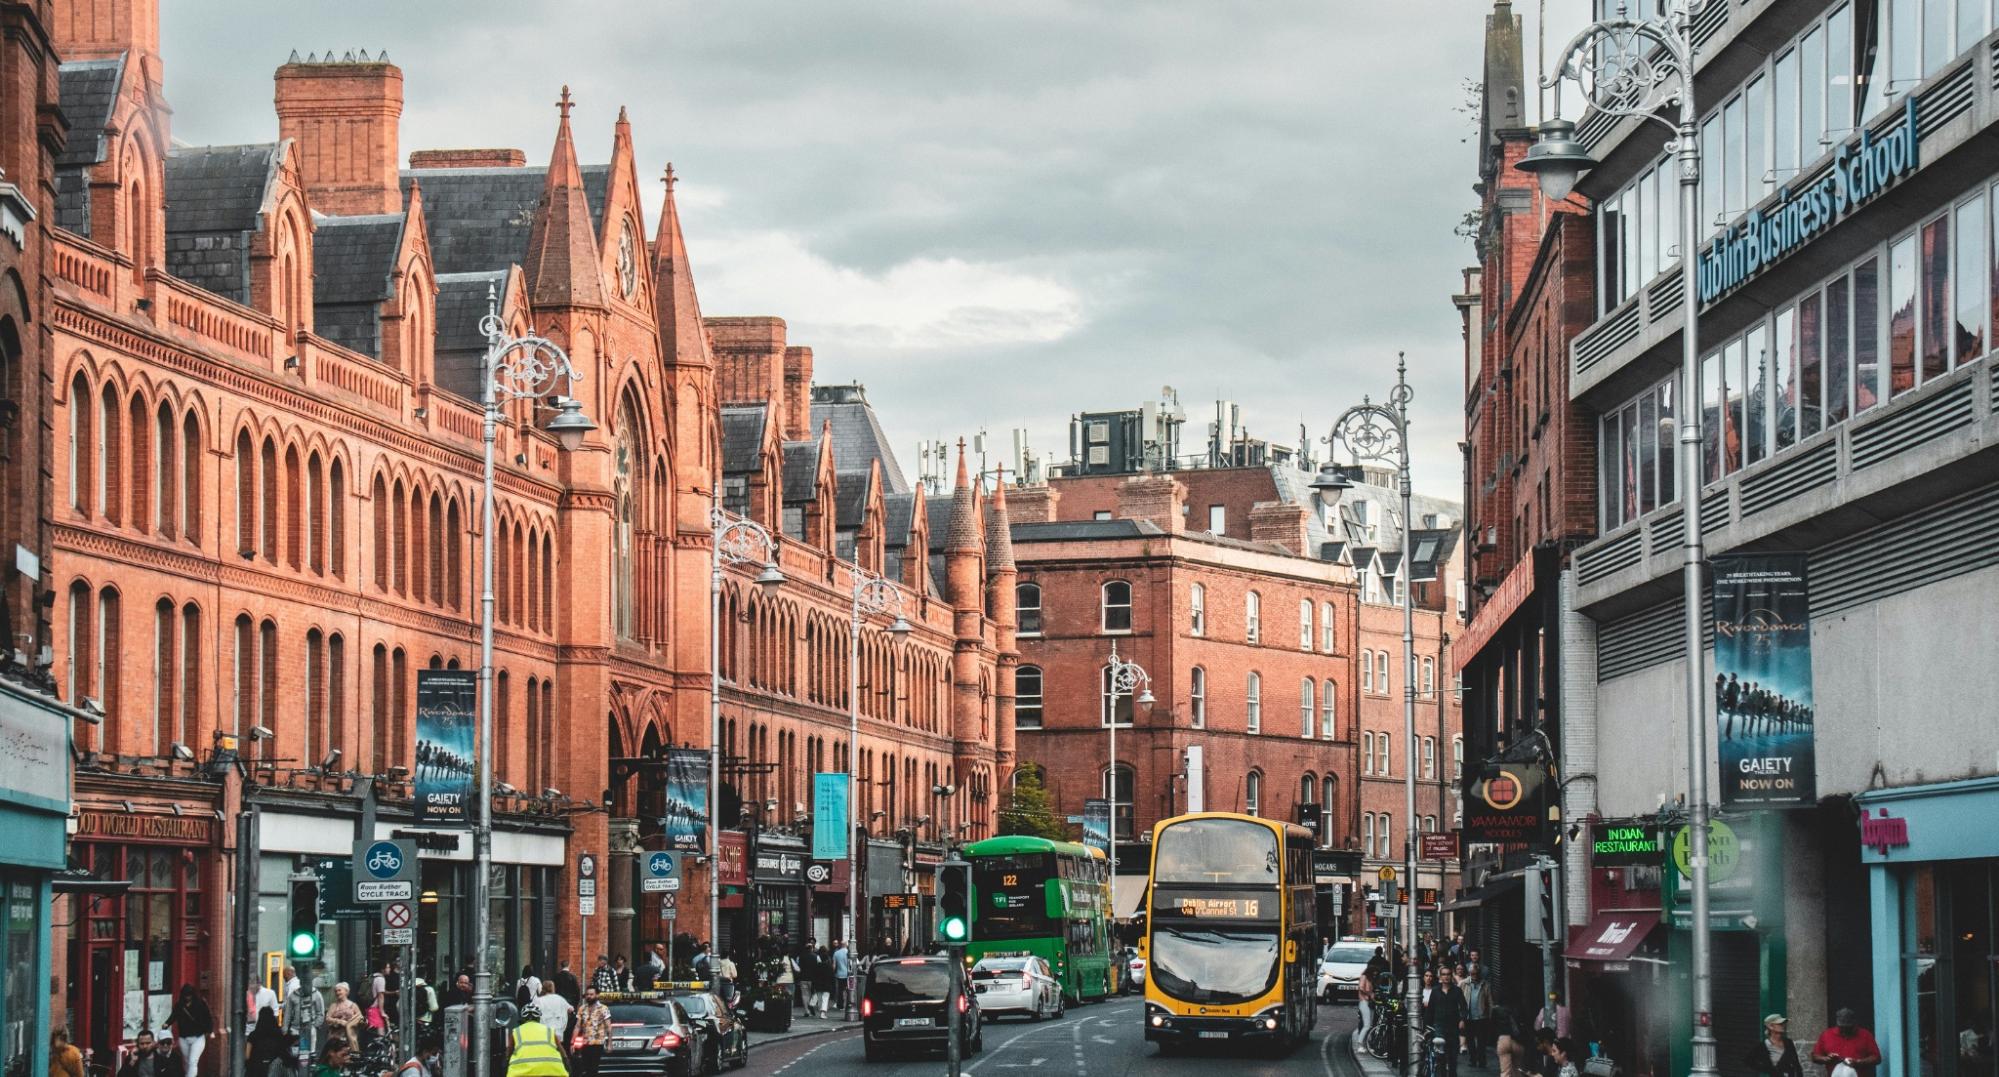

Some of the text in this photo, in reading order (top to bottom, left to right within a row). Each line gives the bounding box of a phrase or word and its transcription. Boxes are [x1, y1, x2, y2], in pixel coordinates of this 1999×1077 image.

[1697, 96, 1918, 303] ublin Business School
[1739, 757, 1792, 773] GAIETY
[1740, 778, 1794, 790] NOW ON
[427, 793, 461, 803] GAIETY
[448, 806, 461, 814] ON
[102, 813, 140, 835] WORLD
[143, 816, 208, 839] RESTAURANT
[1471, 815, 1536, 827] YAMAMORI
[1608, 828, 1644, 840] INDIAN
[1595, 840, 1656, 853] RESTAURANT
[1314, 863, 1337, 871] HOGANS
[1003, 874, 1017, 886] 122
[1183, 898, 1236, 908] Dublin Airport
[1244, 899, 1258, 916] 16
[1181, 907, 1193, 915] via
